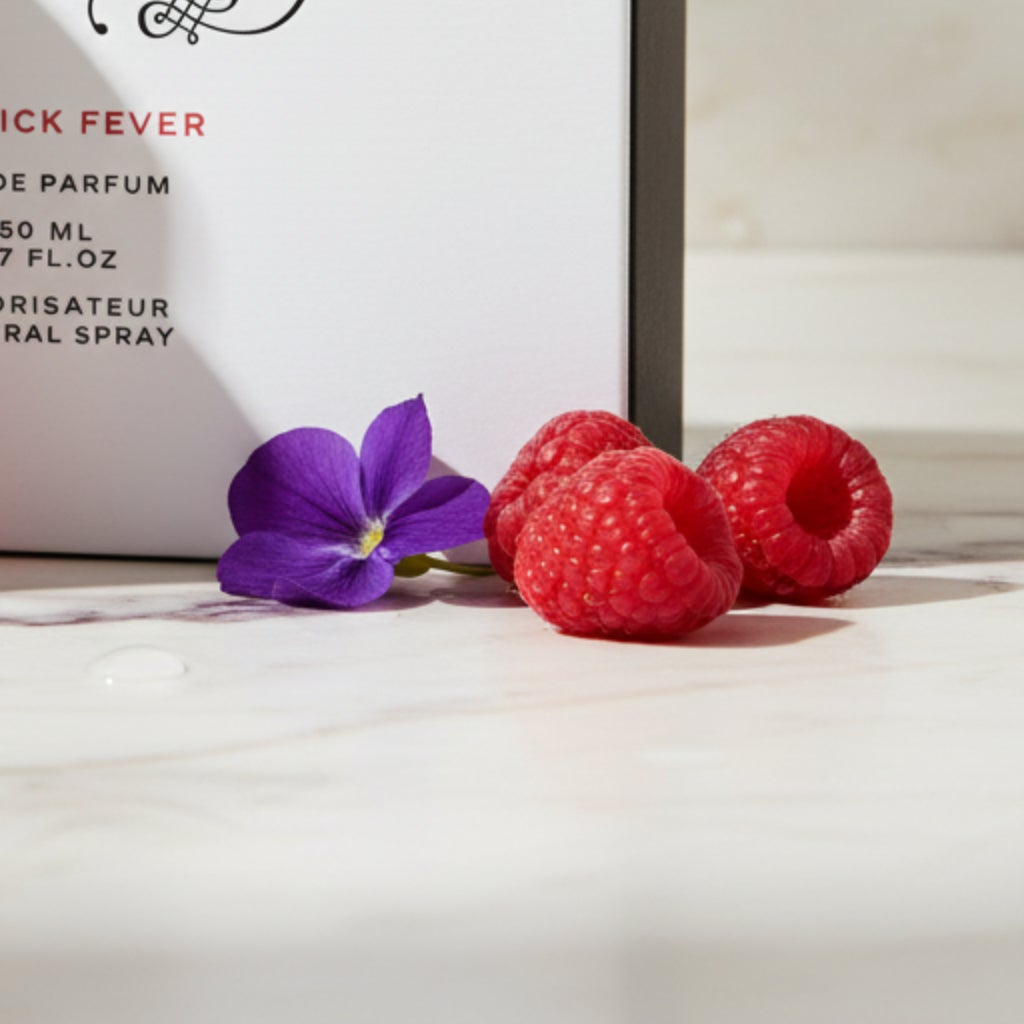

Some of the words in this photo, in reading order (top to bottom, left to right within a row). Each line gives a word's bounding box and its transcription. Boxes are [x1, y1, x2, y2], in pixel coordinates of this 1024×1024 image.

[80, 110, 206, 137] FEVER
[39, 173, 170, 195] PARFUM
[49, 221, 93, 241] ML
[27, 248, 117, 269] FL.OZ
[74, 325, 175, 347] SPRAY
